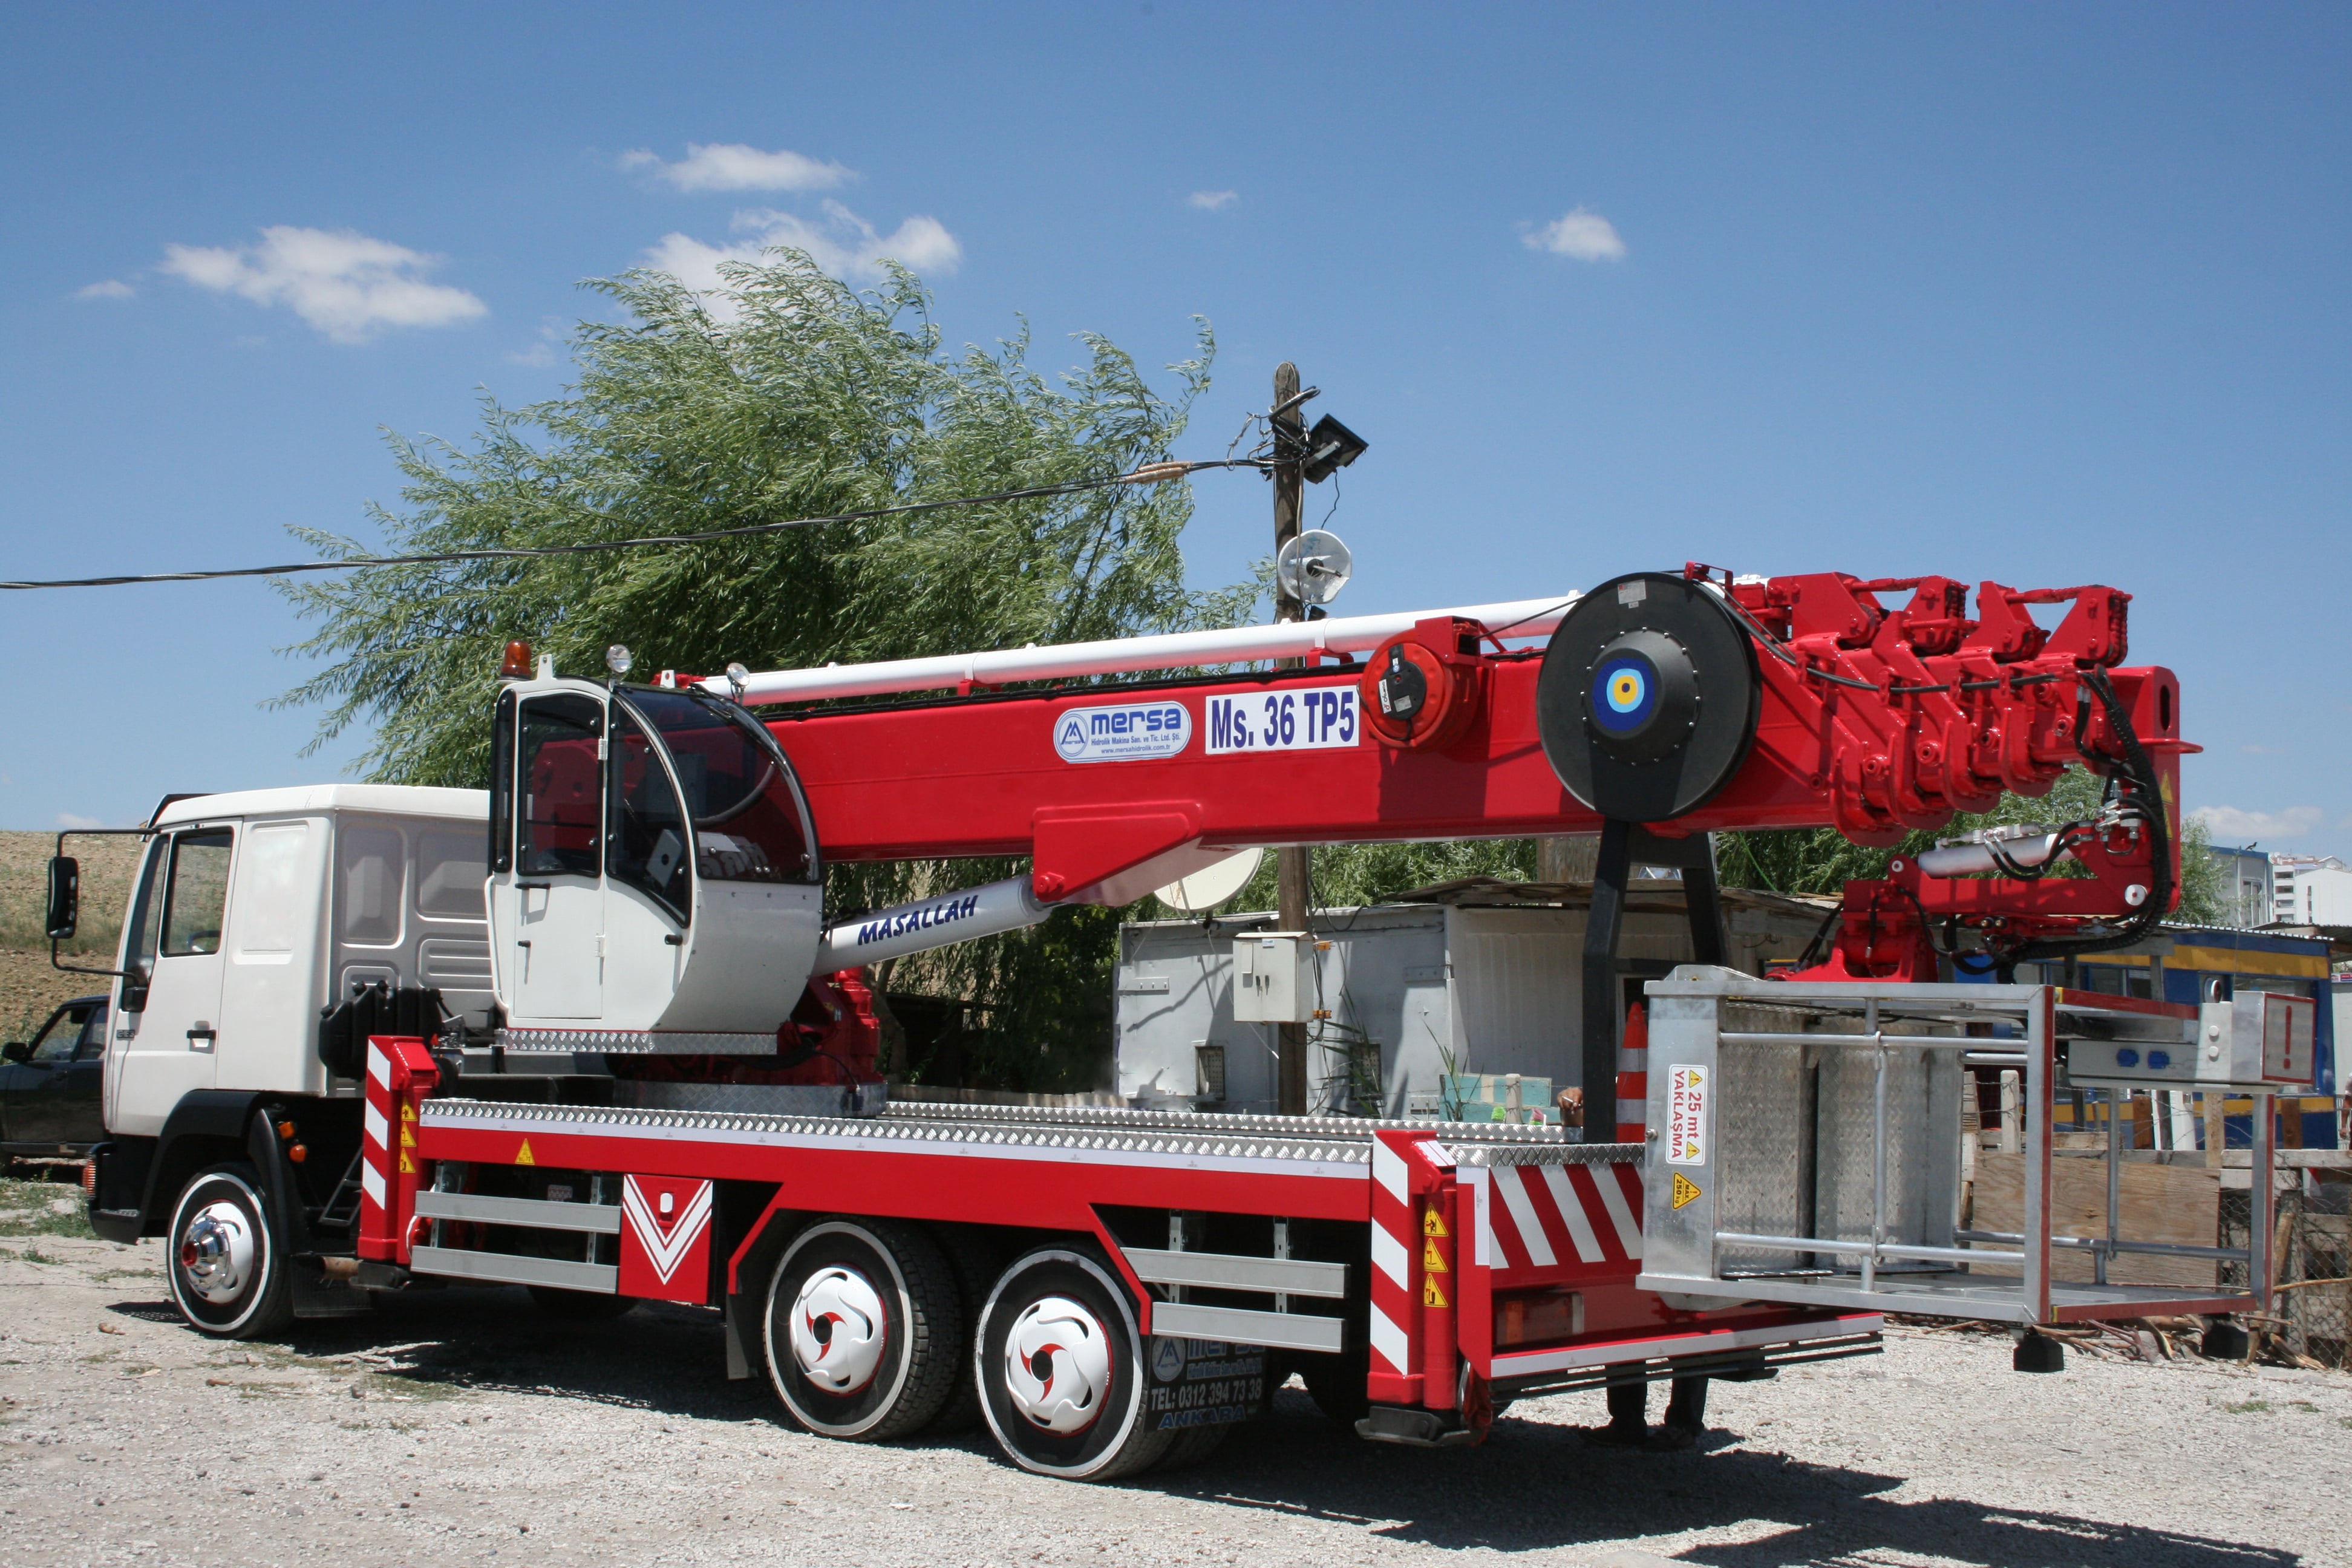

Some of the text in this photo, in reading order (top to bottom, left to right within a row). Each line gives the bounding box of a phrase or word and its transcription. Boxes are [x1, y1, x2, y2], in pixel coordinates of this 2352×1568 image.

[1091, 708, 1181, 734] mersa
[1211, 691, 1354, 749] Ms. 36 TP5
[1091, 737, 1111, 746] Hidrolik
[1131, 735, 1142, 743] San.
[1670, 1070, 1685, 1158] YAKLAŞMA
[1687, 1092, 1702, 1139] 25 mt
[1151, 1377, 1262, 1411] TEL: 0312 394 73 38
[1157, 1404, 1246, 1430] ANKARA
